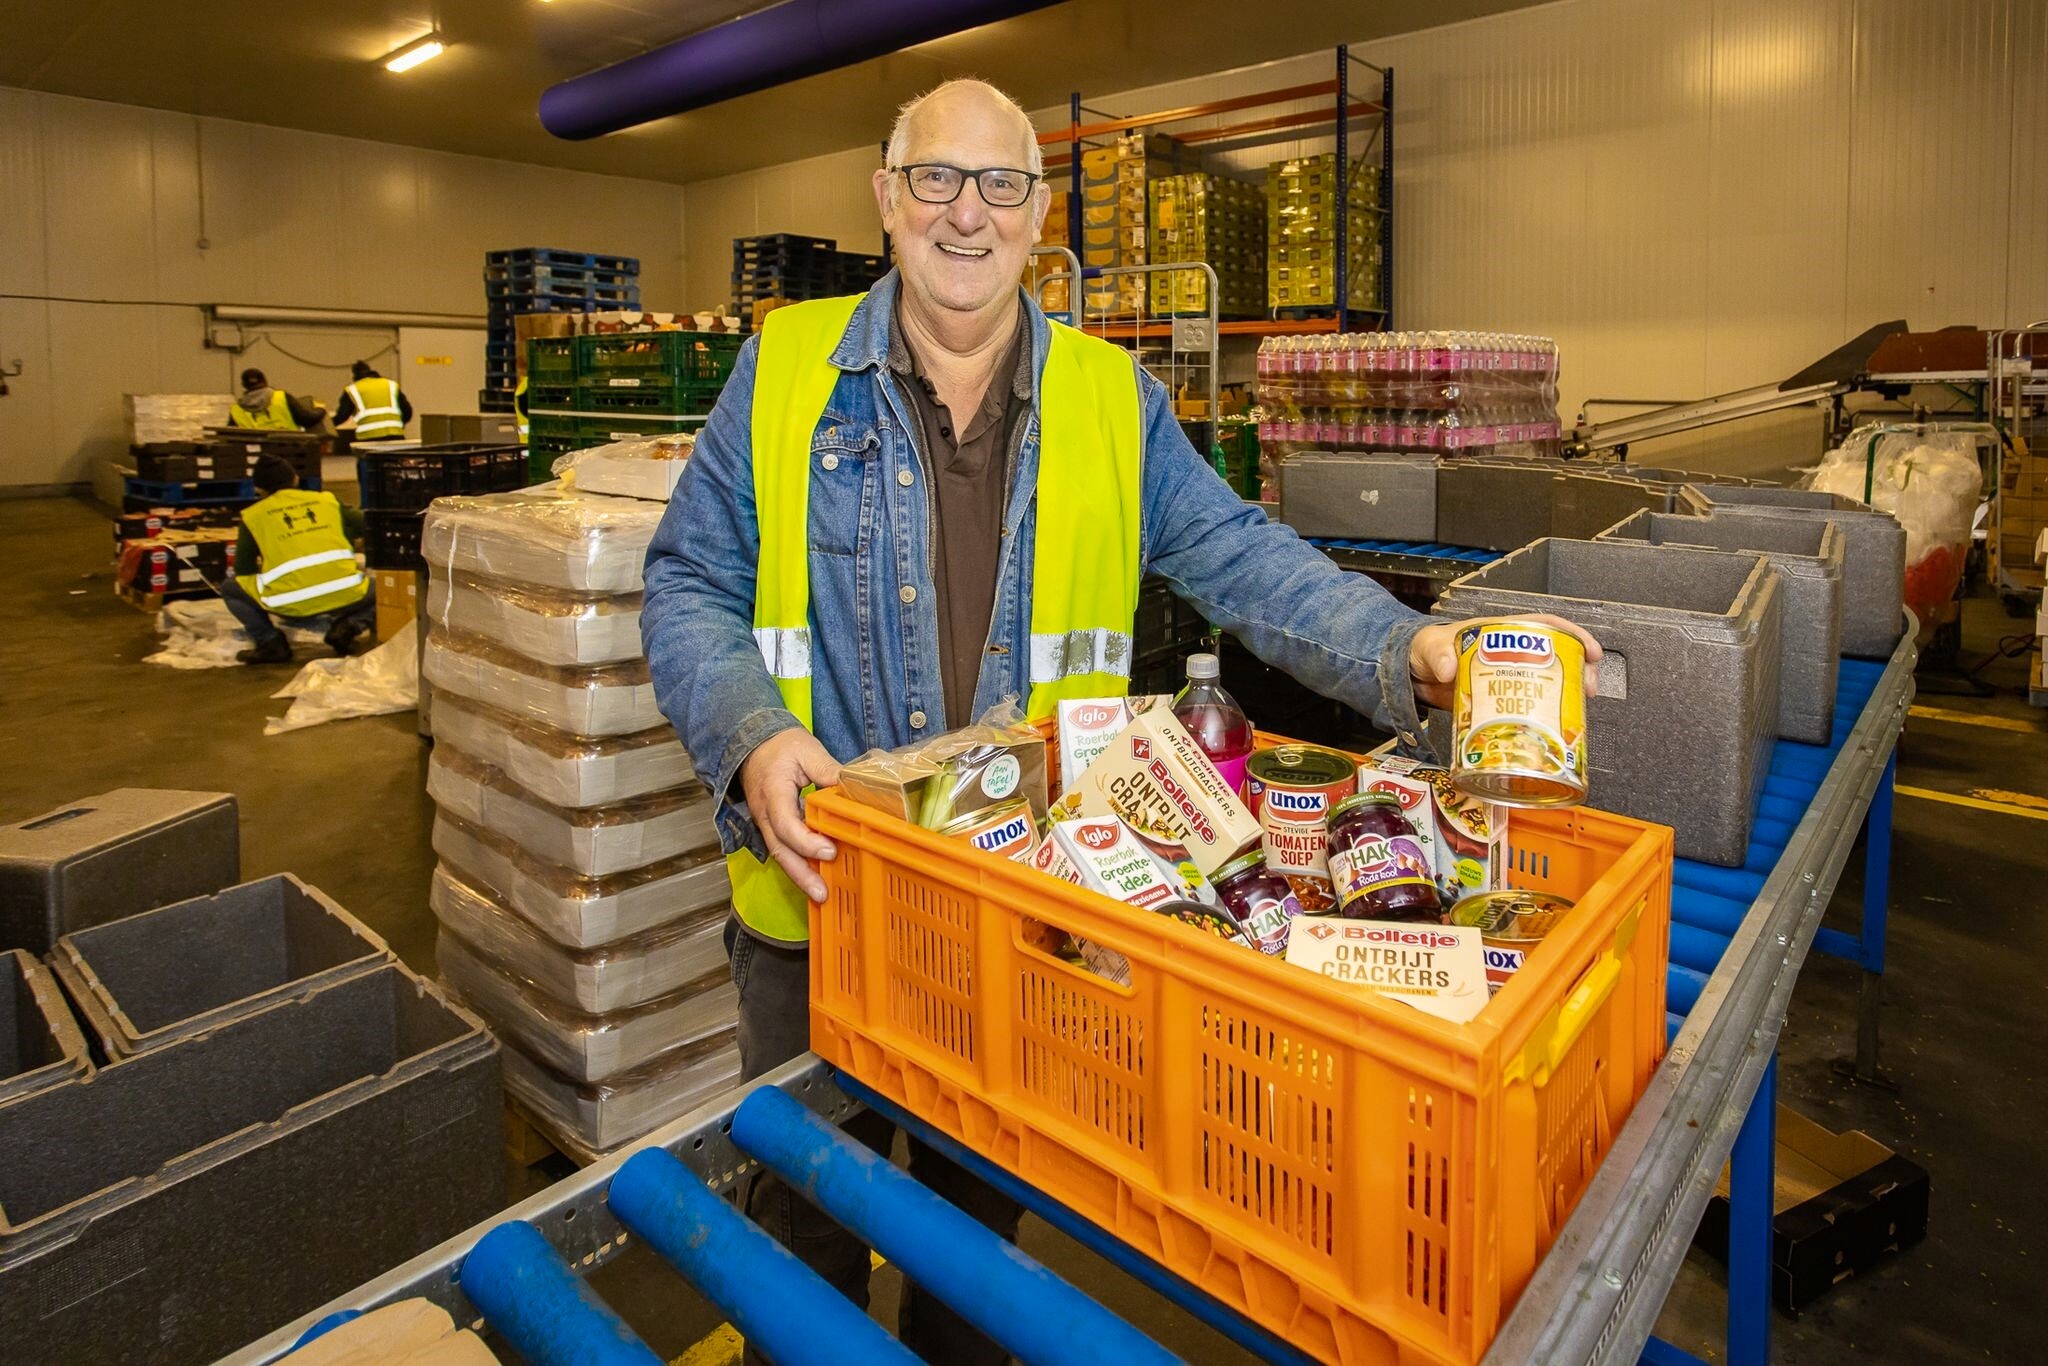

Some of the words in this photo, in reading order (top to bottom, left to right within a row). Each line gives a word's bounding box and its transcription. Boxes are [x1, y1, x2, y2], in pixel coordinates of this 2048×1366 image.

[1486, 632, 1546, 652] unox
[1495, 669, 1535, 678] ORIGINELE
[1488, 680, 1543, 700] KIPPEN
[1495, 697, 1535, 715] SOEP
[1078, 708, 1107, 725] iglo
[1162, 728, 1235, 817] ONTBIJTCRACKERS
[1150, 759, 1215, 844] Bolletje
[1271, 791, 1323, 809] unox
[977, 818, 1027, 850] unox
[1082, 826, 1112, 847] iglo
[1283, 826, 1309, 834] STEVIGE
[1268, 832, 1326, 850] TOMATEN
[1094, 846, 1138, 867] Roerbak
[1281, 850, 1313, 866] SOEP
[1350, 841, 1395, 868] HAK
[1100, 858, 1151, 881] Groente-
[1357, 872, 1380, 886] Rode
[1379, 867, 1398, 880] kool
[1117, 872, 1153, 892] idee
[1248, 904, 1291, 939] HAK
[1344, 927, 1457, 948] Bolletje
[1336, 944, 1435, 968] ONTBIJT
[1321, 961, 1450, 988] CRACKERS
